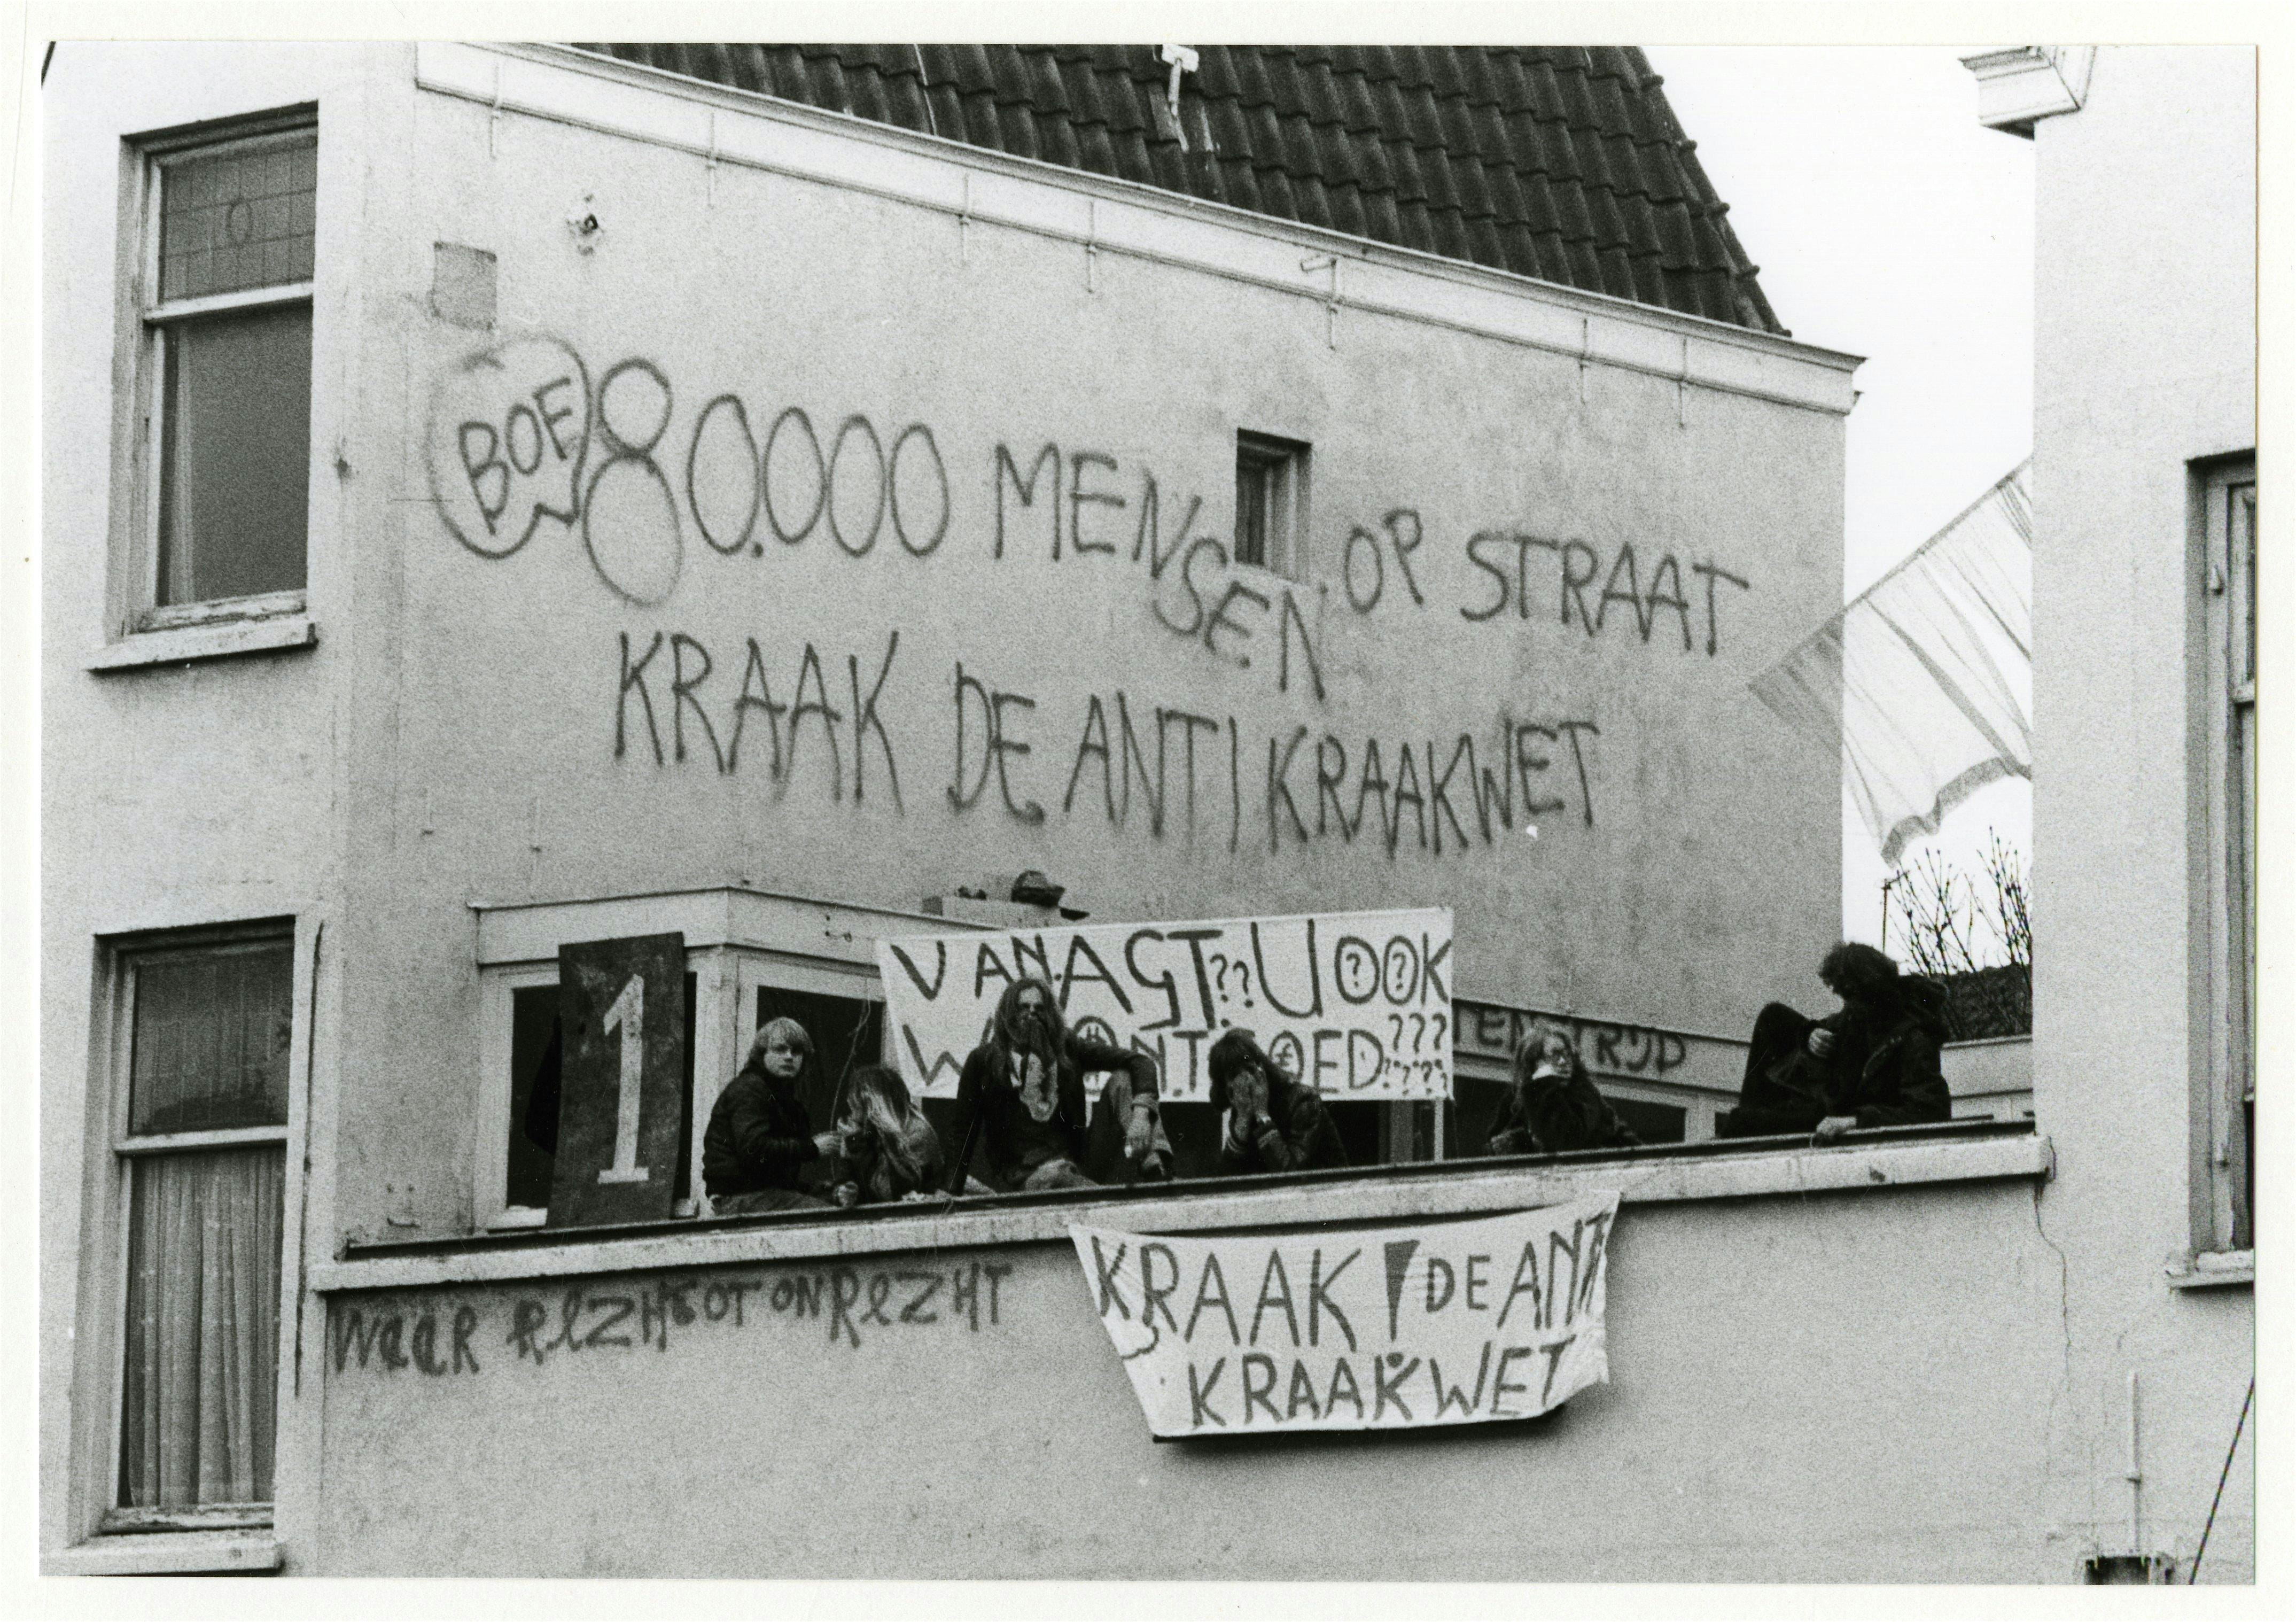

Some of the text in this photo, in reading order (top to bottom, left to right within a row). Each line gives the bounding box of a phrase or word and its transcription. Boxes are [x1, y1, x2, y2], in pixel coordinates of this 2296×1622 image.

[458, 376, 572, 536] BOE
[583, 356, 950, 608] 80.000
[1343, 507, 1423, 615] OP
[1460, 531, 1750, 656] STRAAT
[614, 630, 905, 817] KRAAK
[947, 661, 1046, 828] DE
[597, 973, 649, 1184] 1
[1427, 1253, 1492, 1314] DE
